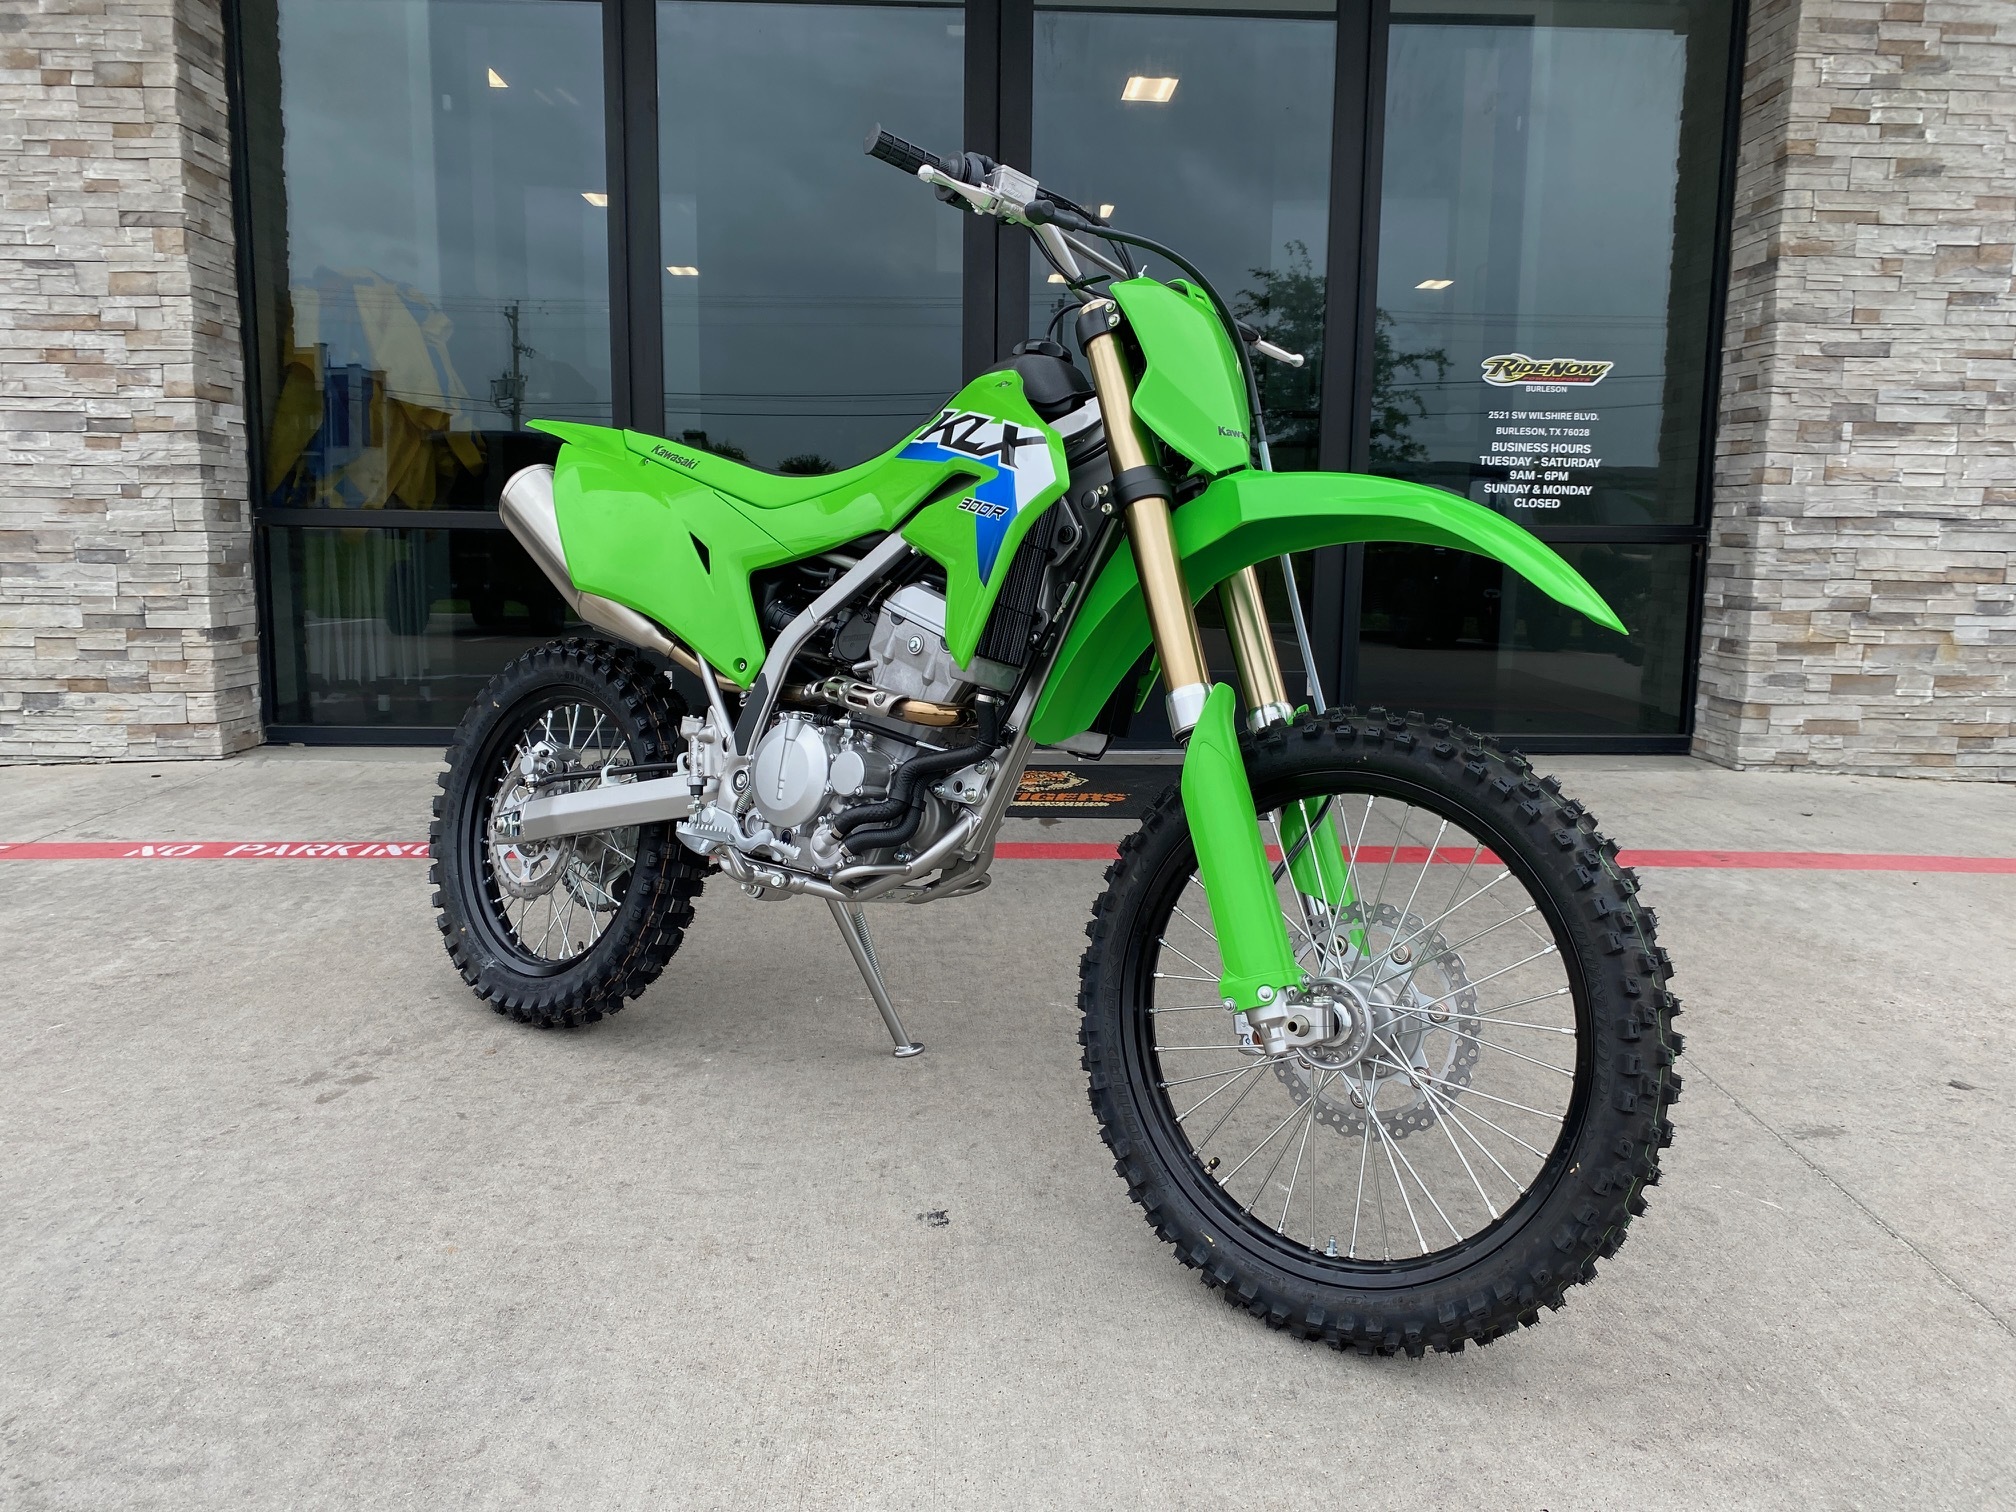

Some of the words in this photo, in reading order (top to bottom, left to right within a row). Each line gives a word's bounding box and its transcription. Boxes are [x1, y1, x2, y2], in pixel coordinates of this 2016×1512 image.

[1525, 385, 1568, 393] BURLESON
[1488, 411, 1509, 419] 2521
[1511, 411, 1527, 419] SW
[1529, 412, 1572, 420] WILSHIRE
[1574, 413, 1600, 421] BLVD.
[1496, 427, 1547, 437] BURLESON,
[1549, 428, 1561, 436] TX
[1563, 428, 1590, 436] 76028
[913, 409, 1047, 470] KLX
[1491, 442, 1549, 453] BUSINESS
[1551, 443, 1592, 454] HOURS
[651, 444, 701, 470] Kawasaki
[1479, 456, 1532, 466] TUESDAY
[1540, 457, 1602, 468] SATURDAY
[1509, 471, 1535, 480] 9AM
[1544, 472, 1569, 481] 6PM
[1484, 484, 1530, 493] SUNDAY
[1532, 485, 1541, 494] &
[1542, 485, 1592, 495] MONDAY
[957, 497, 1009, 521] 300R
[1514, 498, 1561, 508] CLOSED
[1015, 791, 1126, 803] IGERS
[123, 844, 204, 857] NO
